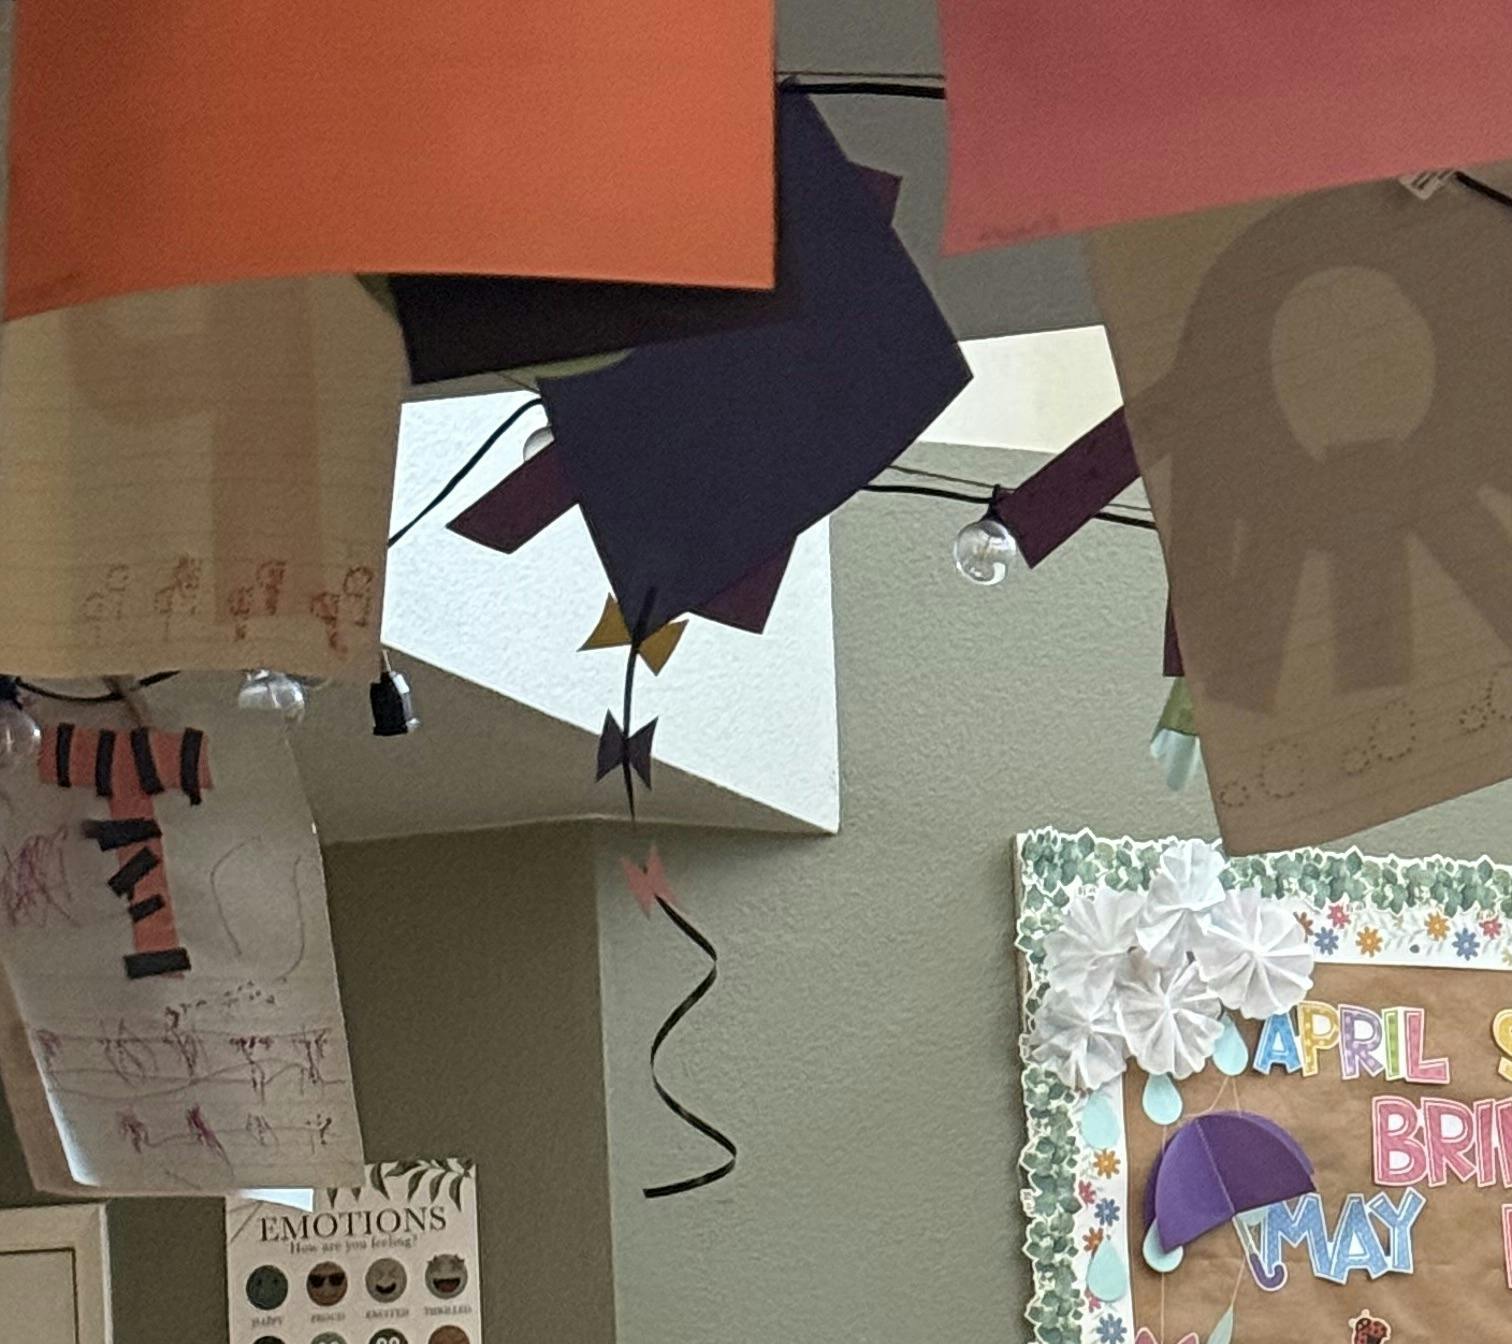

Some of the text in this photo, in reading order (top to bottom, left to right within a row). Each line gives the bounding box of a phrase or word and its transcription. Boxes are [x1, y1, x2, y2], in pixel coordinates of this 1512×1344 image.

[1253, 1002, 1450, 1085] APRIL
[260, 1206, 447, 1242] EMOTIONS
[290, 1235, 418, 1255] How are you feeling?
[1256, 1187, 1426, 1285] MAY
